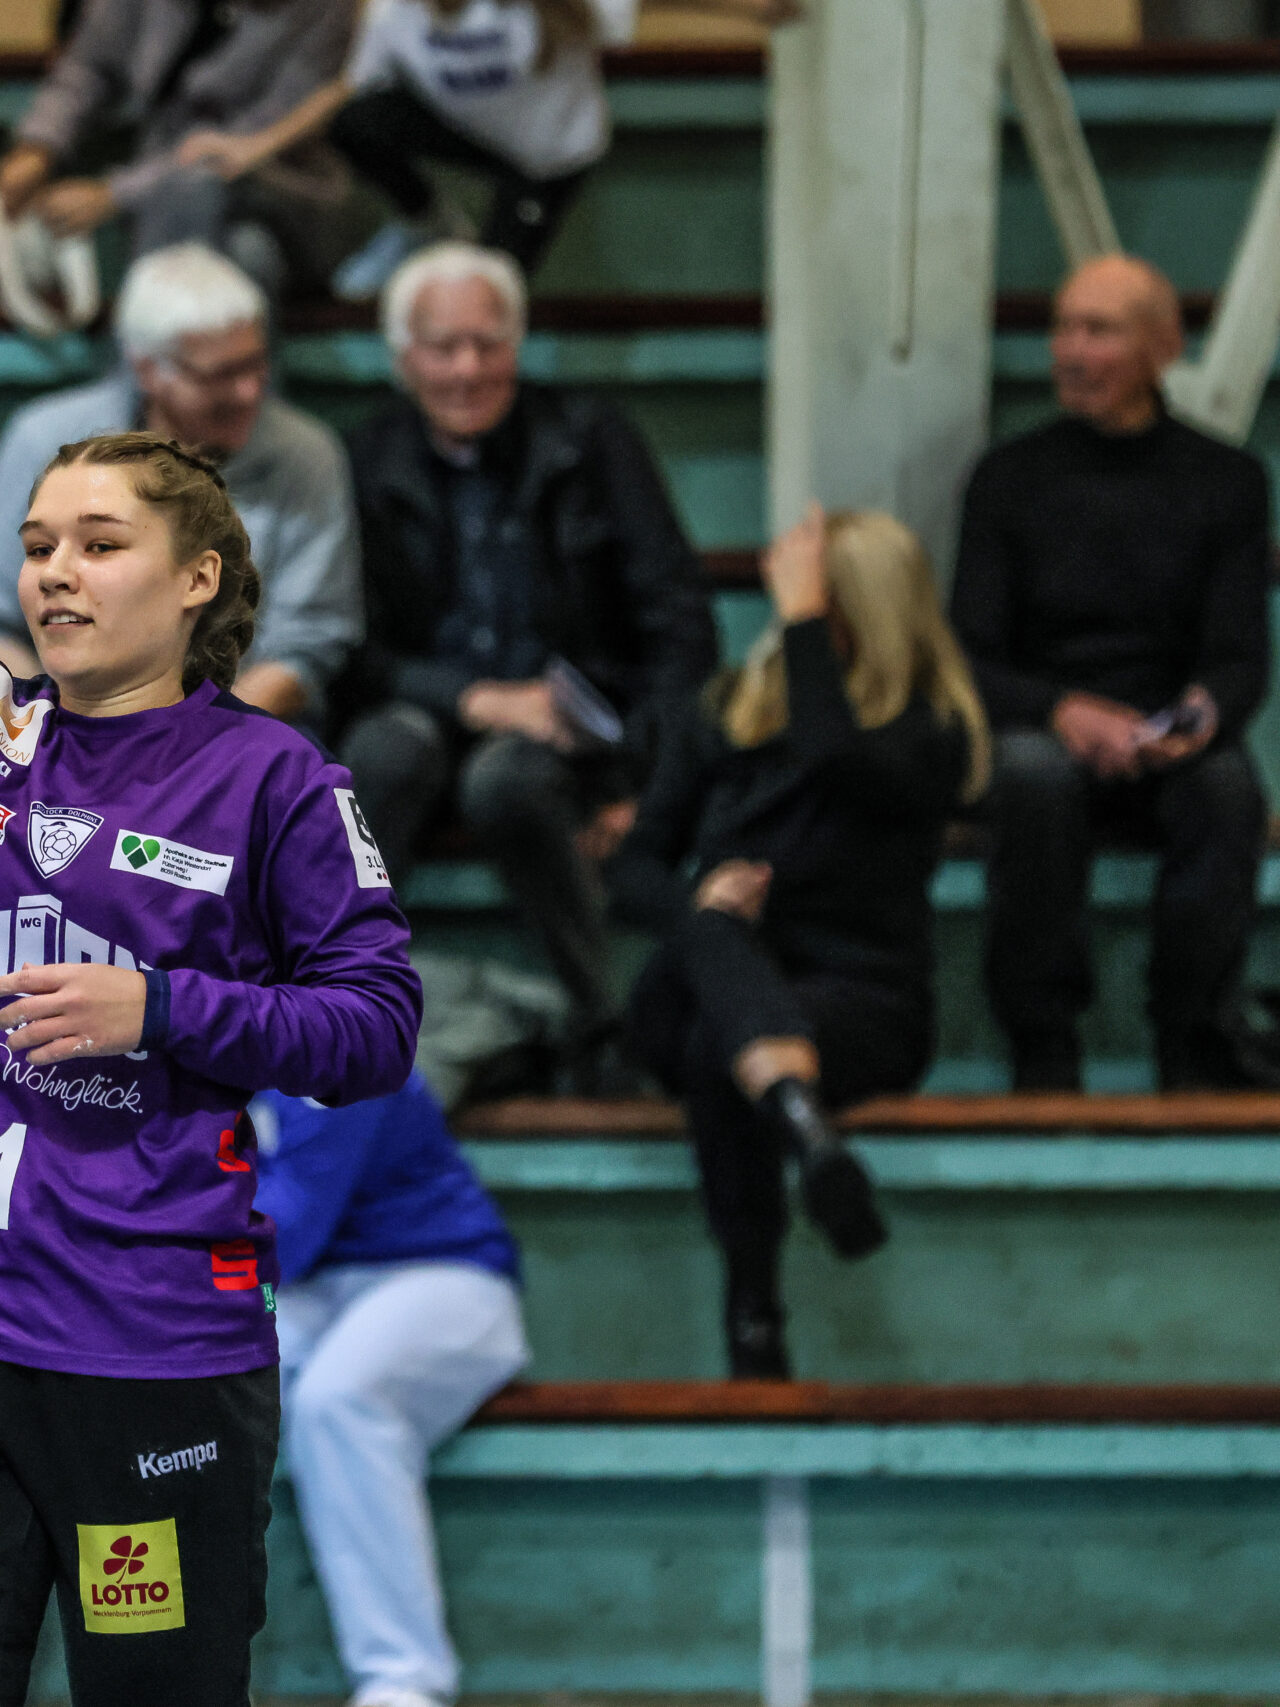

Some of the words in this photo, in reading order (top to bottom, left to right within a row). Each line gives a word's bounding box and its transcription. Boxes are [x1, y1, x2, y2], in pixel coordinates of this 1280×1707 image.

[67, 809, 99, 824] DOLPHINS
[20, 917, 42, 929] WG
[137, 1440, 218, 1479] Kempa
[91, 1581, 170, 1606] LOTTO
